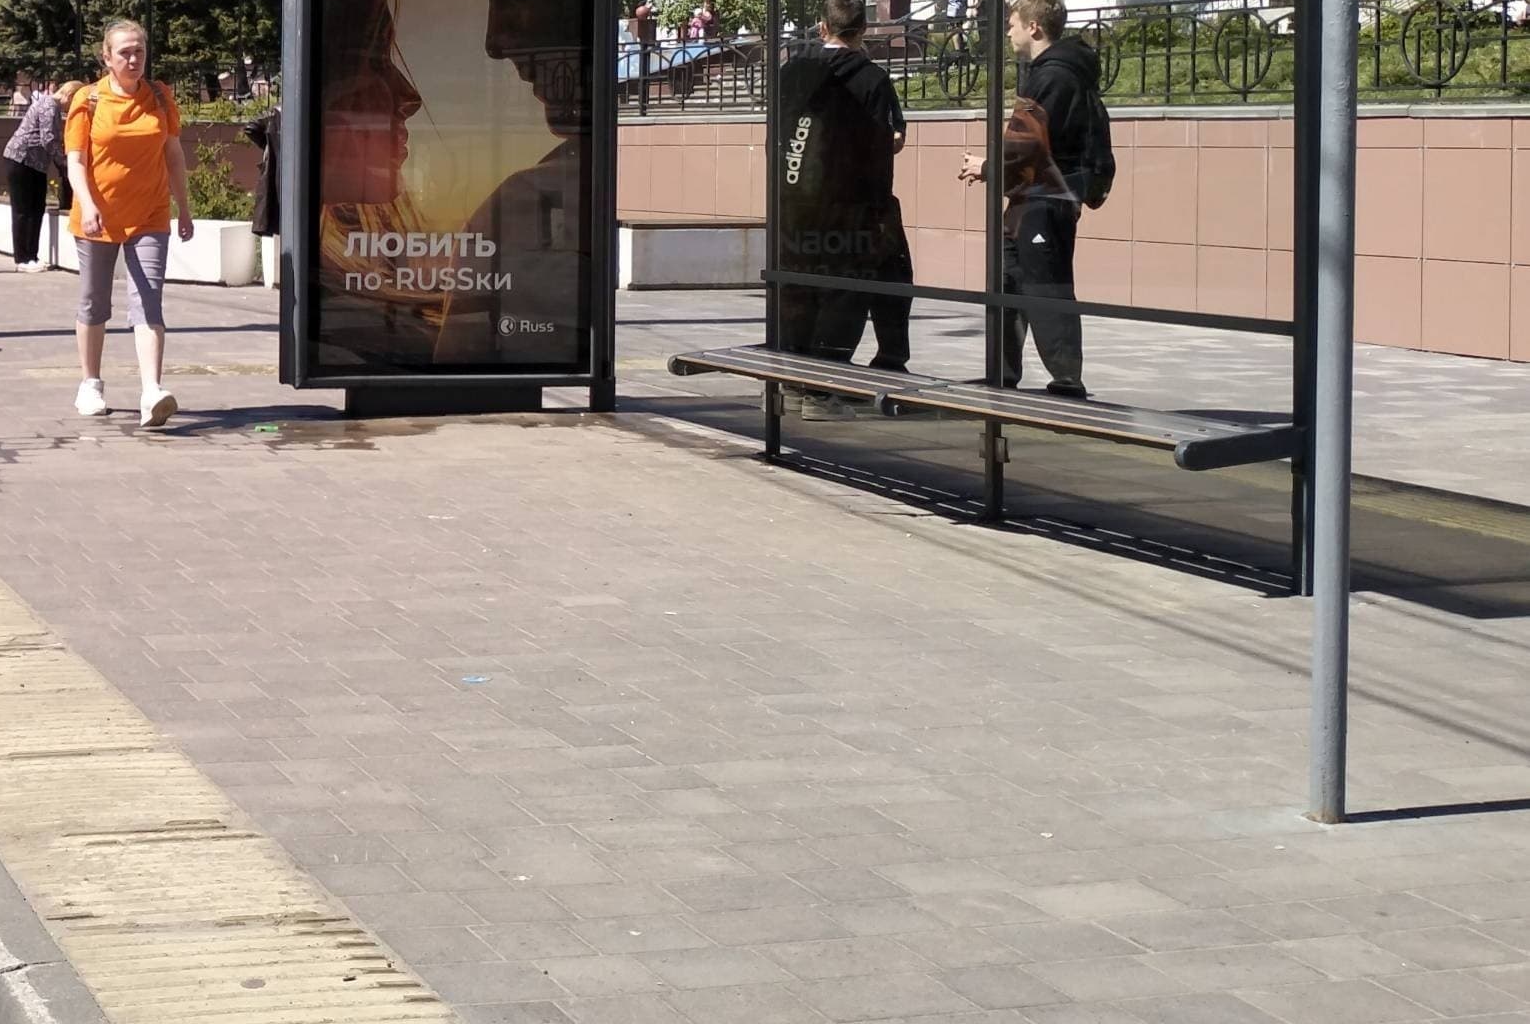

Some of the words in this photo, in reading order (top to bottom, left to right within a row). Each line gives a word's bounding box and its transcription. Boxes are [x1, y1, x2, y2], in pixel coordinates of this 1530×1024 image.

[785, 116, 812, 185] adidas
[343, 232, 497, 258] ЛЮБИТЬ
[345, 267, 513, 291] по-RUSSки
[519, 319, 555, 334] Russ
